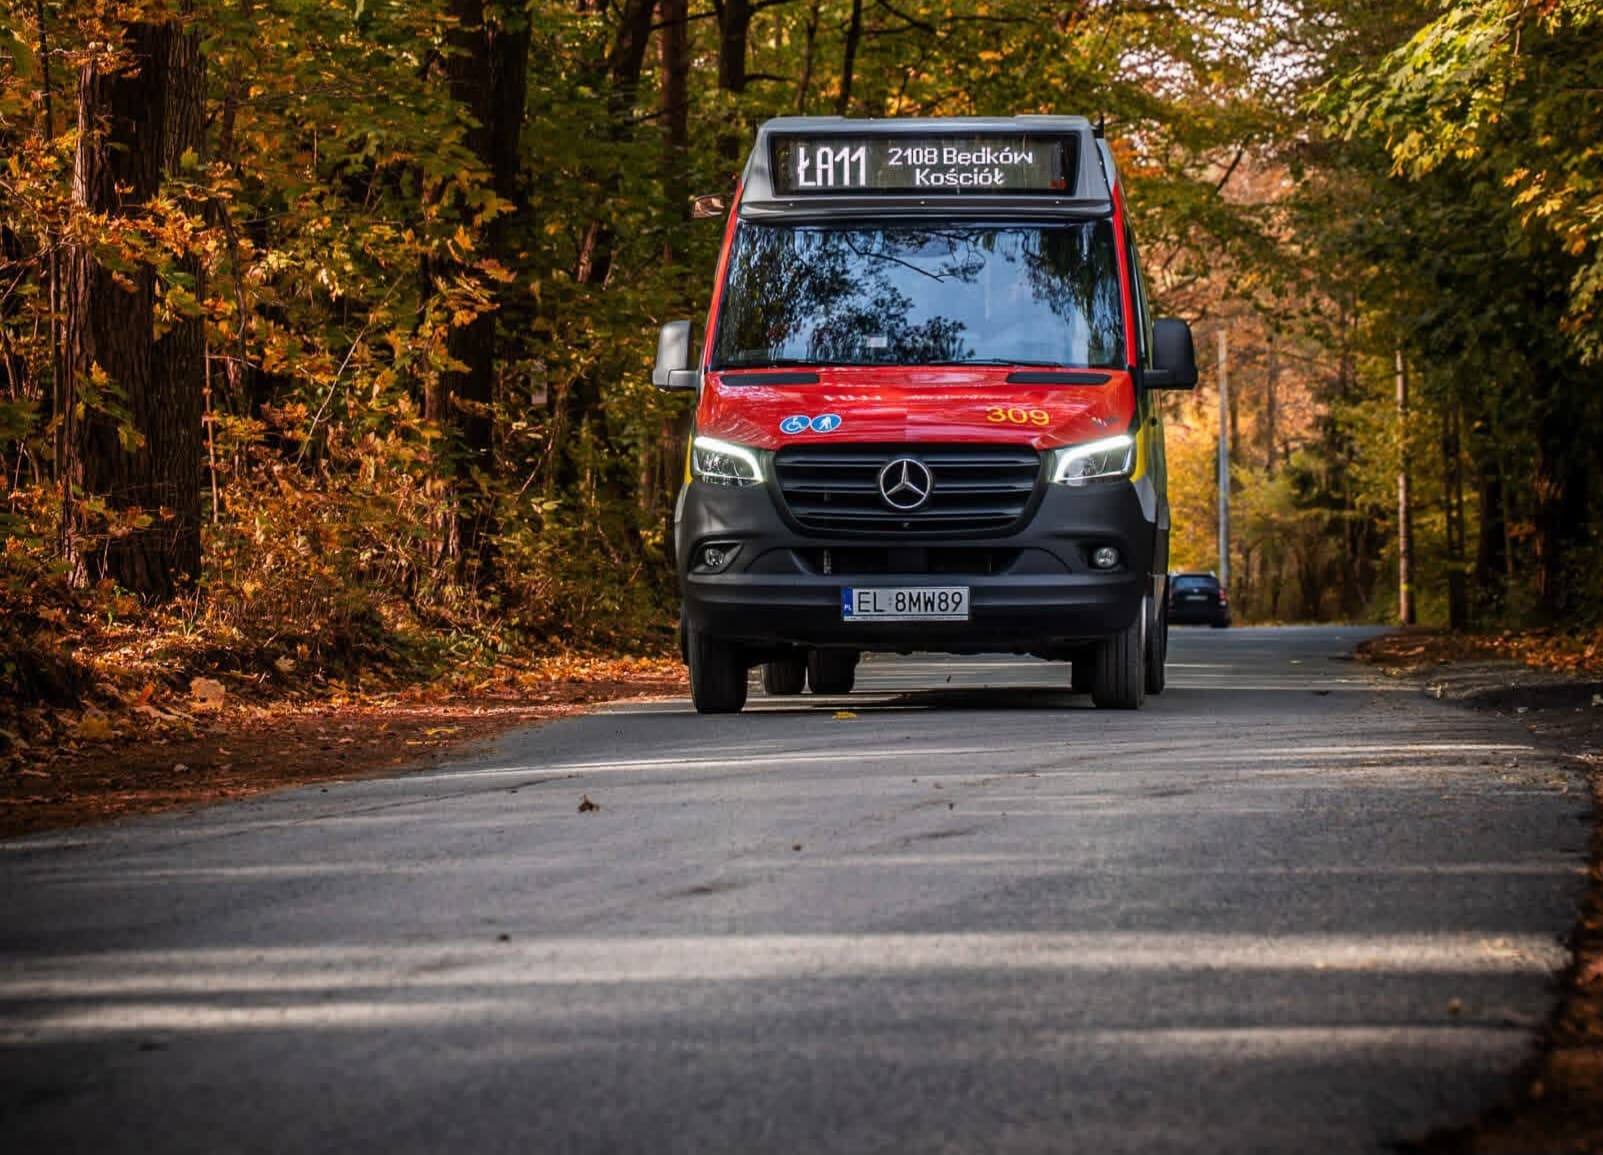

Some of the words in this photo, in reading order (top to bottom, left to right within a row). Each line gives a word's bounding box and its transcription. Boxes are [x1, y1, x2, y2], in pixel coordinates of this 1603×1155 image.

[798, 146, 866, 186] ŁA11
[888, 147, 938, 165] 2108
[943, 145, 1033, 166] Będków
[915, 168, 1005, 186] Kościół
[986, 406, 1049, 426] 309
[858, 591, 885, 612] EL
[895, 591, 963, 612] 8MW89
